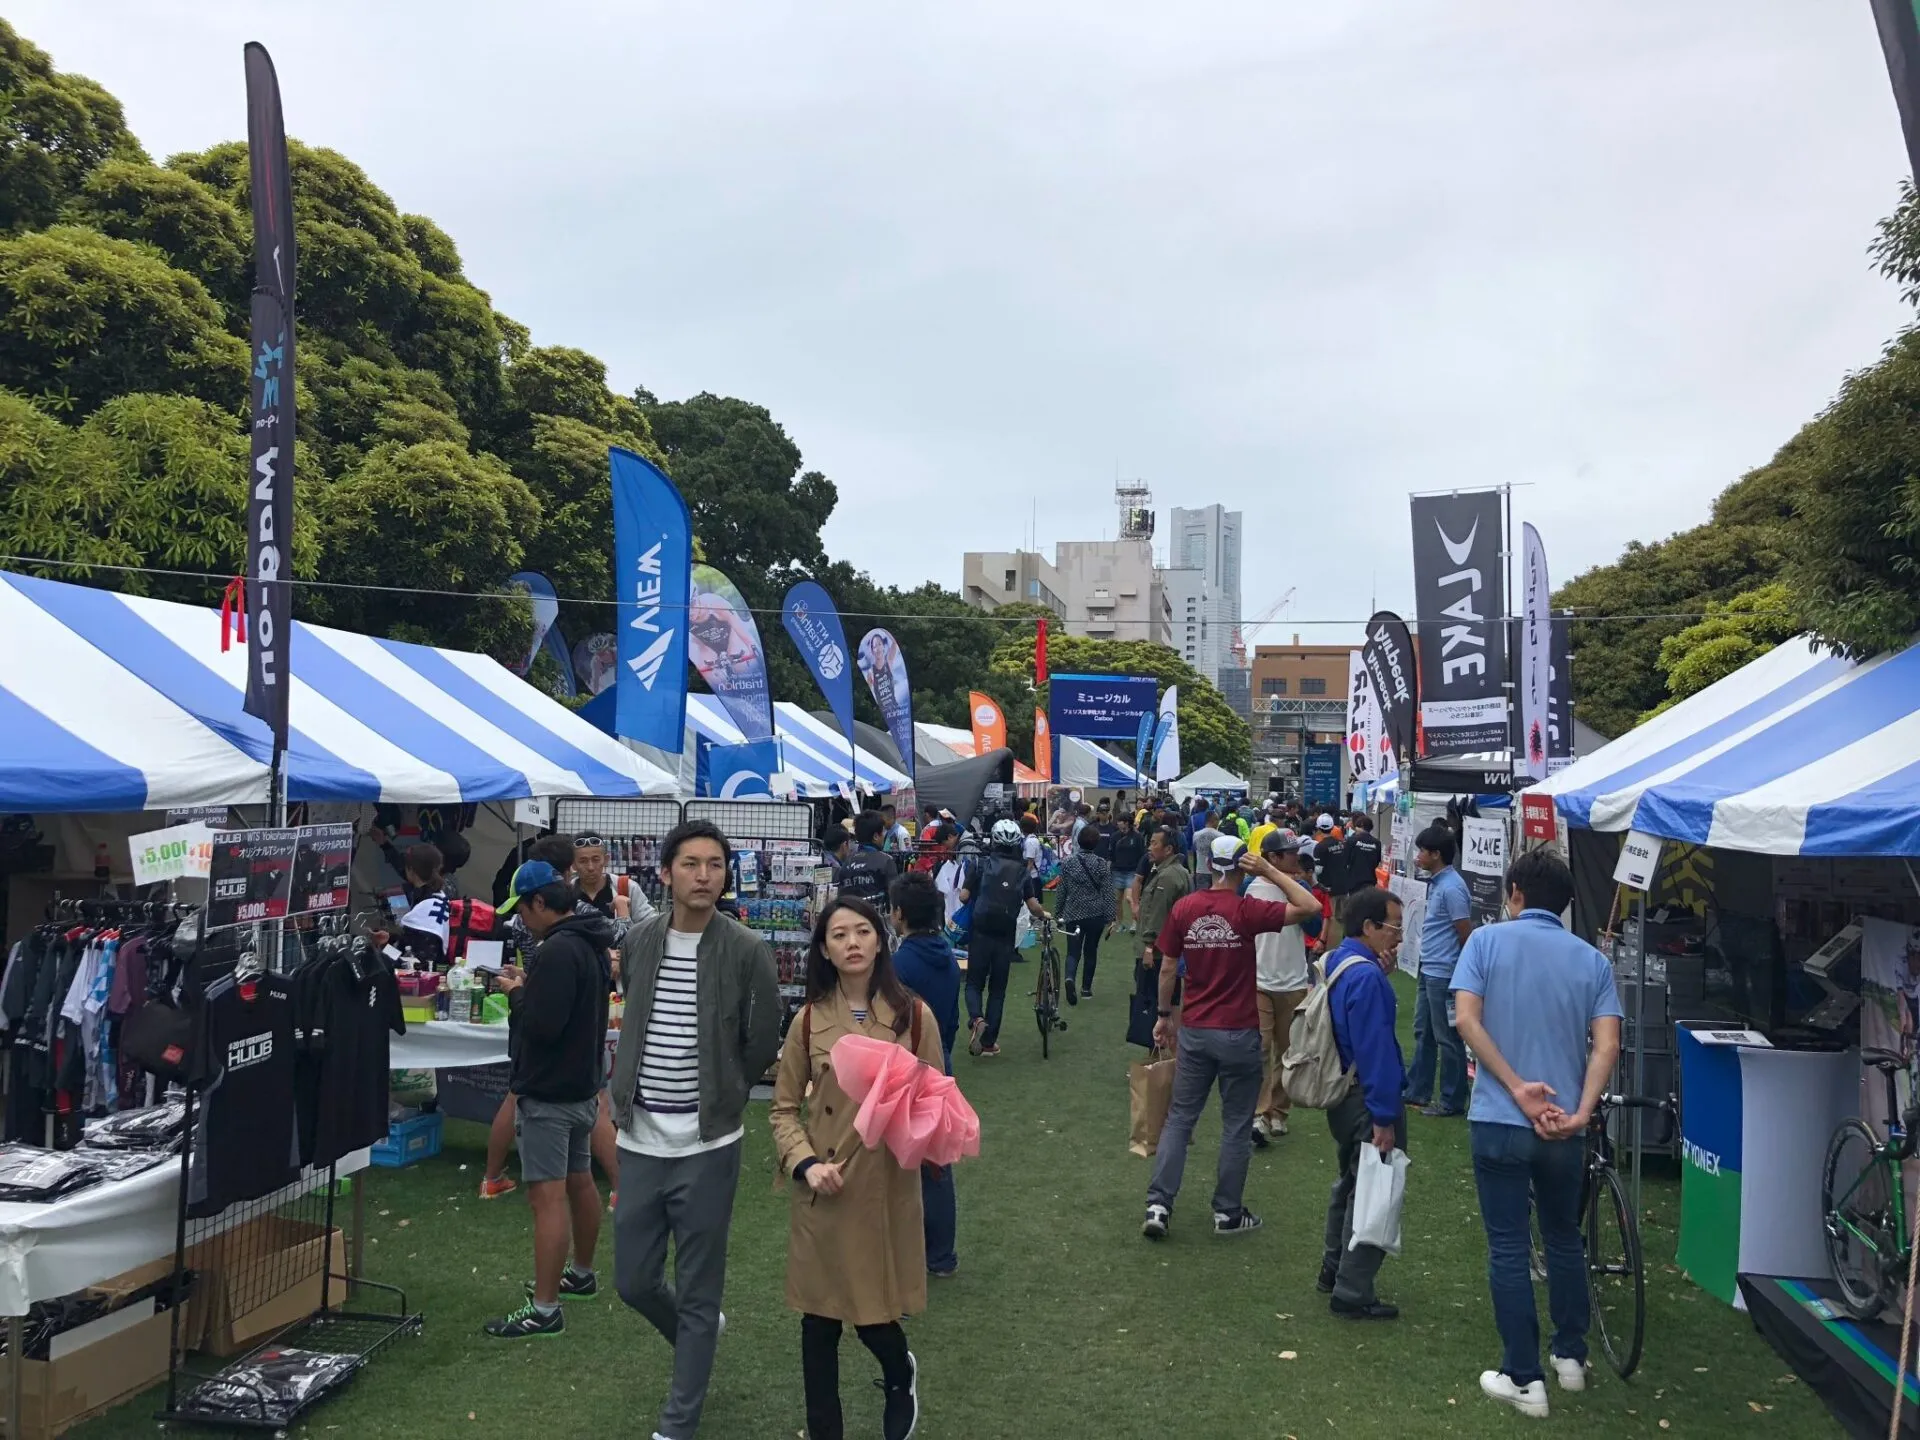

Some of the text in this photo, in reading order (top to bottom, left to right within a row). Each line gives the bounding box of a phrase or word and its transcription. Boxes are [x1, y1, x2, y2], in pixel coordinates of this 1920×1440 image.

[1077, 692, 1132, 704] ミュージカル
[214, 829, 297, 844] HUUB WTS Yokohama
[298, 828, 313, 838] UUB
[238, 845, 295, 857] オリジナルTシャツ
[311, 839, 352, 851] オリジナルPOLO
[1477, 836, 1501, 856] LAKE
[215, 882, 247, 897] HUUB
[269, 990, 288, 1000] HUUB
[228, 1040, 273, 1067] HUUB
[1690, 1142, 1721, 1177] YONEX
